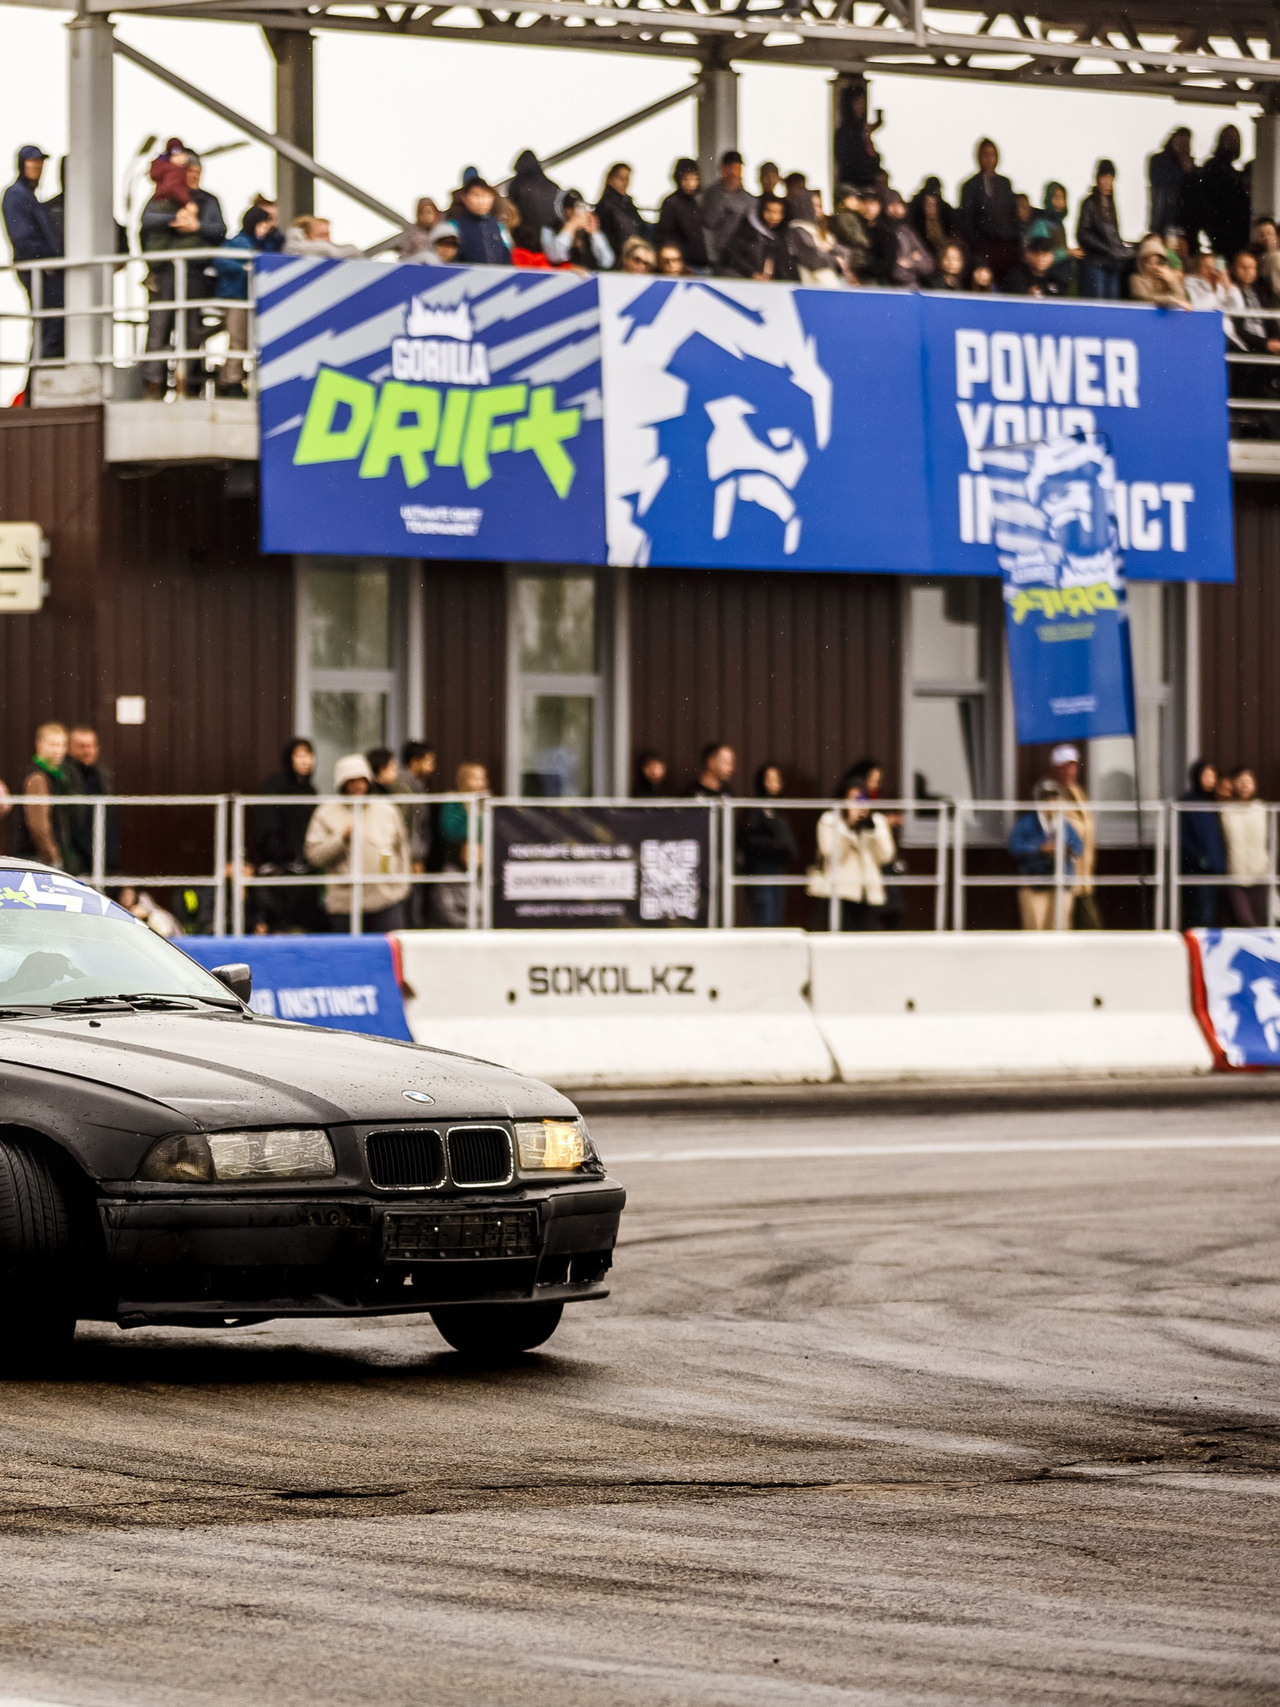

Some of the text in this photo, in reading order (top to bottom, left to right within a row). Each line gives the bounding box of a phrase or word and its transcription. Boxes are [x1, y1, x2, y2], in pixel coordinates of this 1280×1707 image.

[392, 339, 490, 386] GORILLA
[955, 328, 1140, 409] POWER
[293, 367, 582, 500] DRIFT
[276, 984, 379, 1019] INSTINCT
[527, 965, 697, 996] SOKOL.KZ
